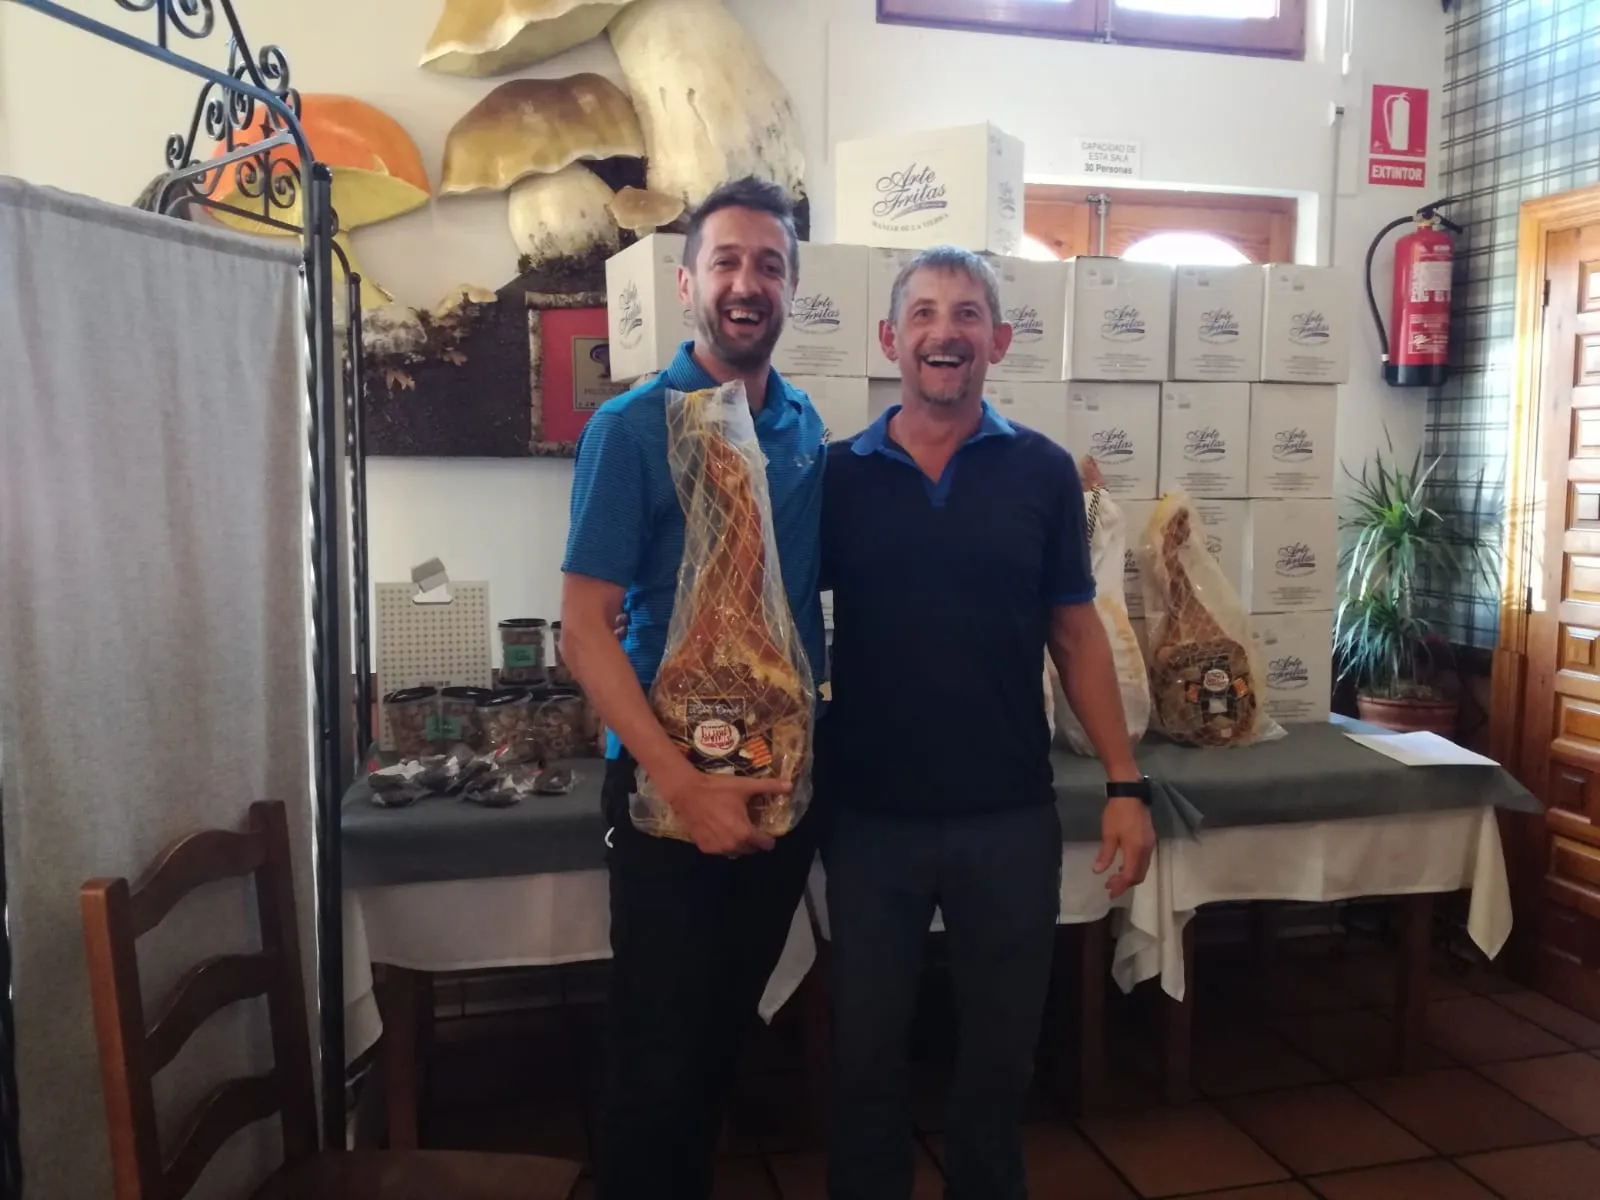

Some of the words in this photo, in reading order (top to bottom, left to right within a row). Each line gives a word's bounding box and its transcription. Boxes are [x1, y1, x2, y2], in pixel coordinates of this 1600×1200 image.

[1081, 142, 1125, 153] CAPACIDAD
[1088, 152, 1108, 161] ESTA
[1110, 153, 1129, 162] SALA
[1095, 163, 1133, 174] Personas
[1372, 164, 1423, 181] EXTINTOR
[876, 162, 936, 192] Arte
[872, 184, 946, 217] Fritas
